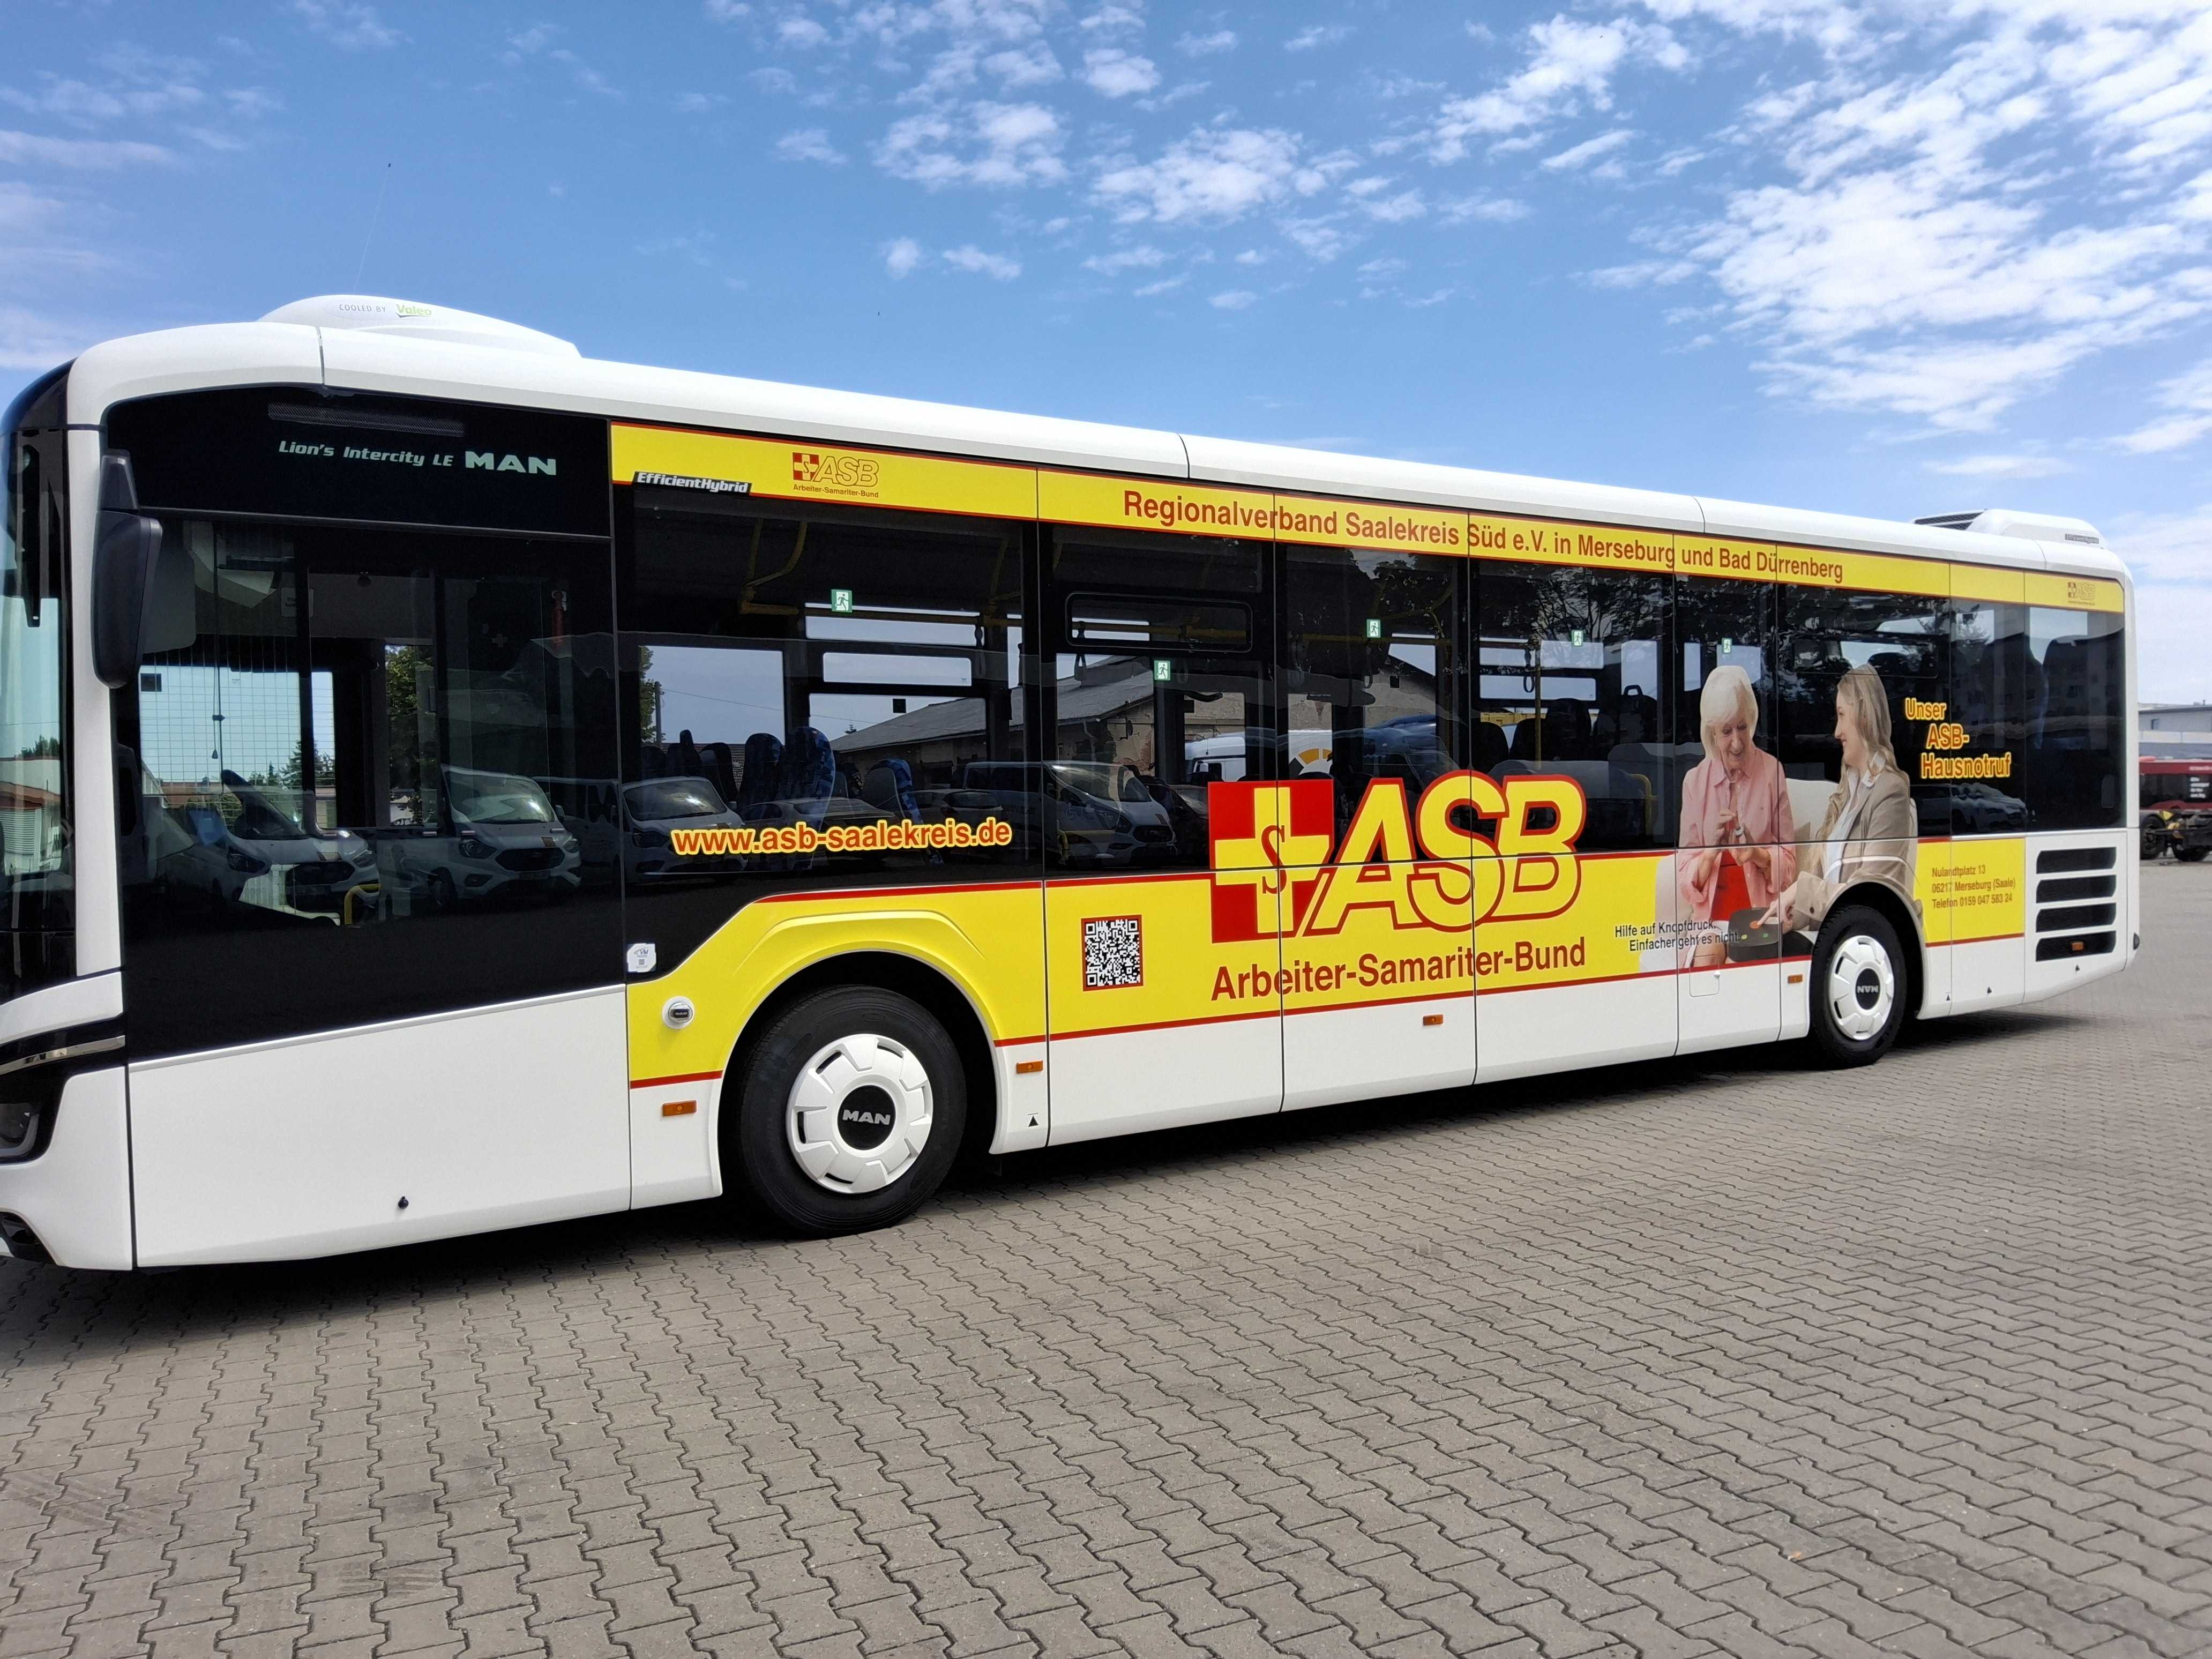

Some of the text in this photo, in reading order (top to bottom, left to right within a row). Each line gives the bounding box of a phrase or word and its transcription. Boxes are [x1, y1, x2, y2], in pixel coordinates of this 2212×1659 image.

[396, 304, 432, 316] Valeo
[279, 440, 454, 466] Lion's Intercity LE
[465, 451, 556, 475] MAN
[812, 455, 879, 487] ASB
[637, 472, 749, 493] EfficientHybrid
[793, 484, 879, 498] Arbeiter-Samariter-Bund
[1124, 490, 1843, 584] Regionalverband Saalekreis Süd e.V. in Merseburg und Bad Dürrenberg
[1905, 698, 1947, 720] Unser
[1926, 723, 1970, 749] ASB-
[1921, 752, 2011, 778] Hausnotruf
[671, 817, 1012, 855] www.asb-saalekreis.de
[1302, 769, 1586, 937] ASB
[1932, 865, 1986, 878] Nulandtplatz 13
[1932, 877, 2016, 893] 06217 Merseburg (Saale)
[1932, 898, 1958, 909] Telefon
[1960, 896, 1976, 907] 0159
[1978, 895, 1990, 905] 047
[2005, 893, 2013, 902] 24
[1615, 920, 1715, 937] Hilfe auf Knopfdruck.
[1630, 930, 1740, 951] Einfacher geht es nicht.
[1210, 936, 1586, 1001] Arbeiter-Samariter-Bund
[1857, 985, 1878, 993] MAN
[842, 1109, 891, 1125] MAN
